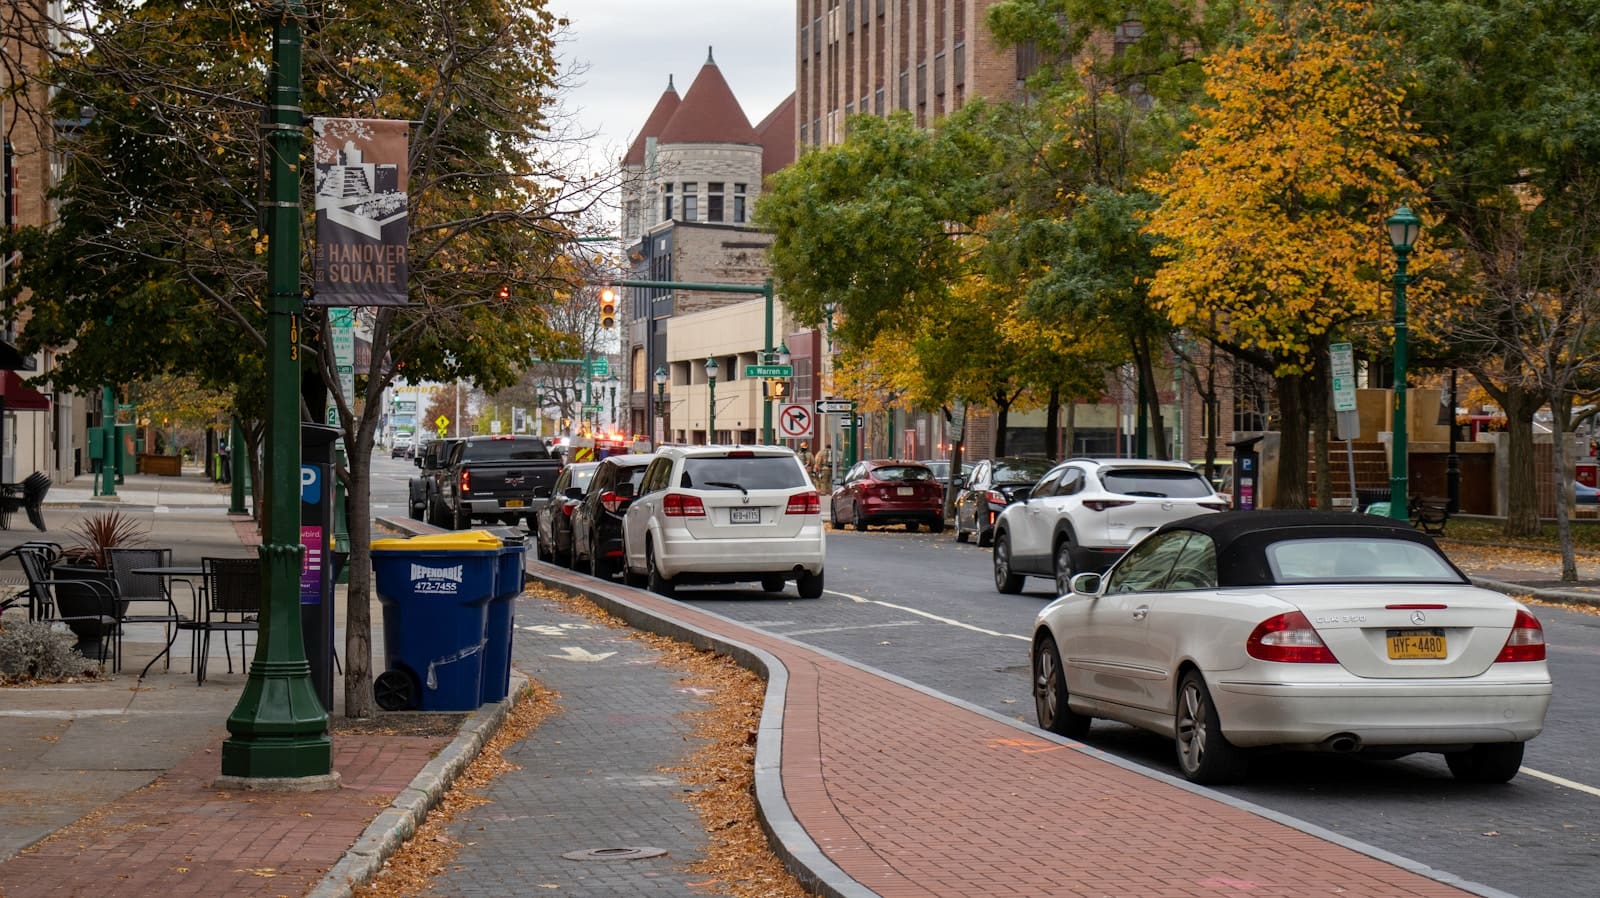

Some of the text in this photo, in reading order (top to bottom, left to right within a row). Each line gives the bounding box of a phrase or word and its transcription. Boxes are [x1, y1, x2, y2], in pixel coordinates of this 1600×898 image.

[329, 243, 406, 264] HANOVER
[329, 264, 397, 284] SQUARE
[757, 366, 781, 375] Warren
[300, 467, 317, 497] P
[411, 563, 463, 583] DEPENDABLE
[414, 582, 457, 591] 472-7455
